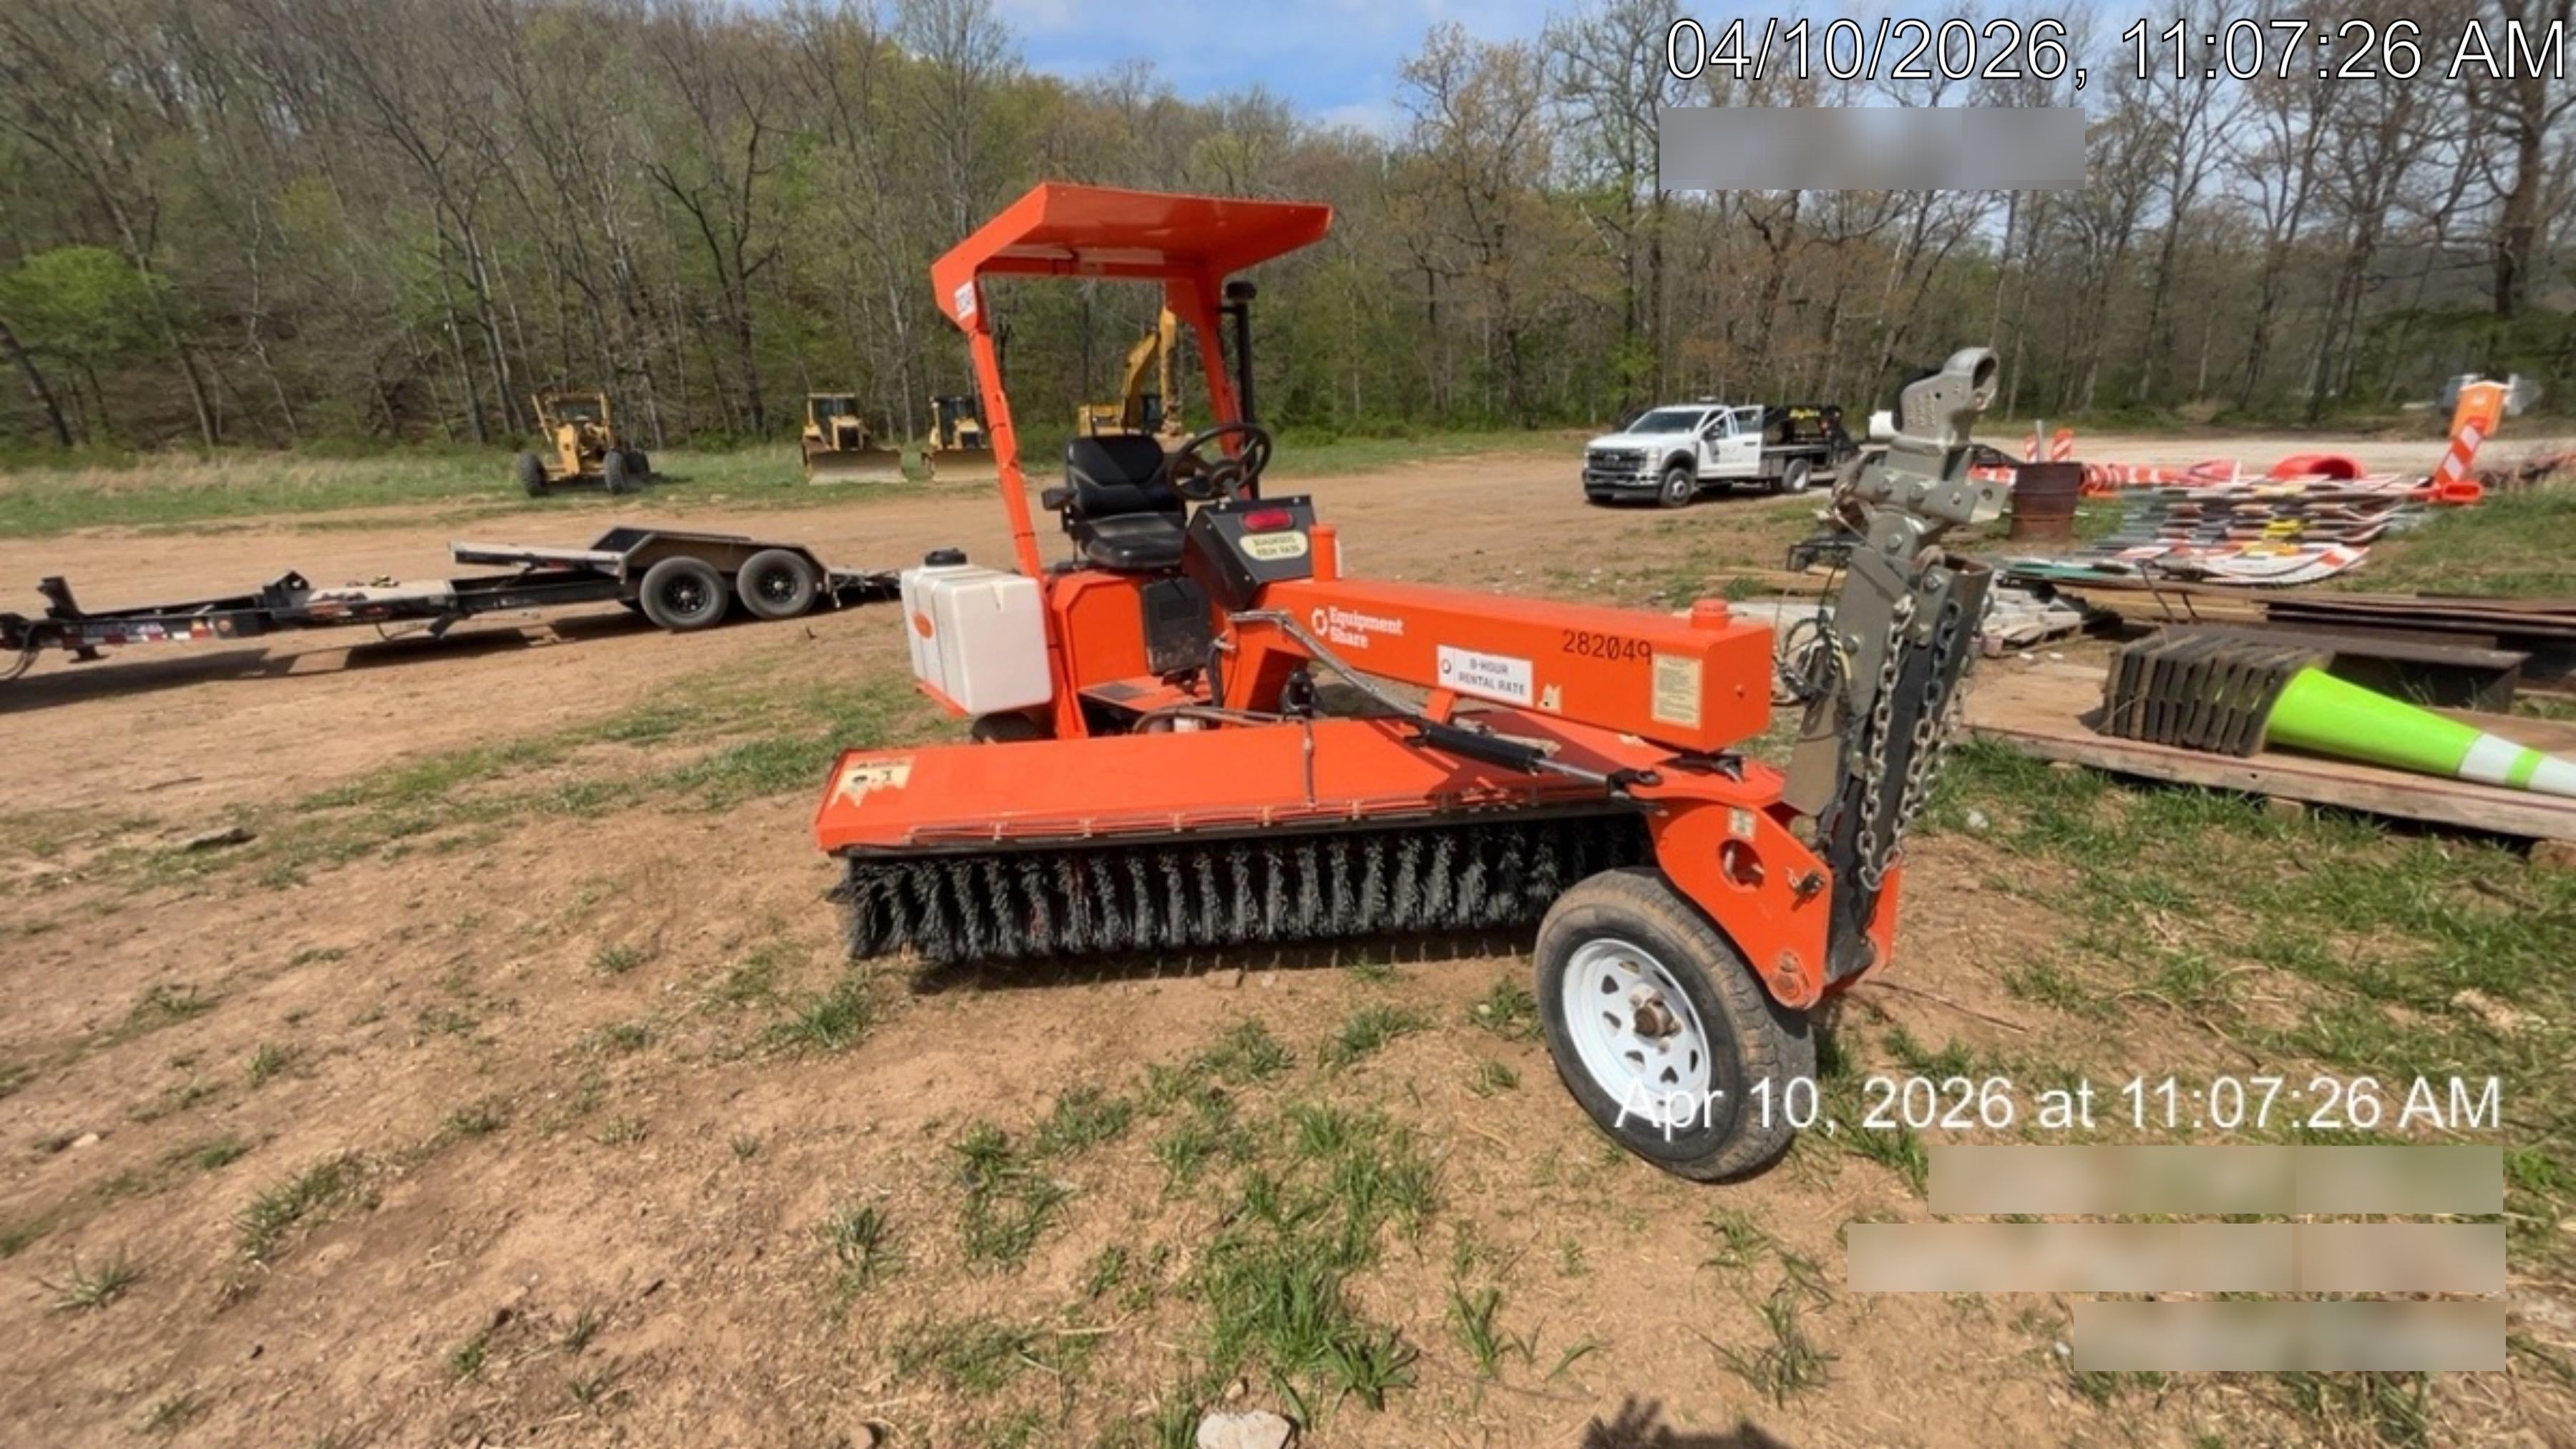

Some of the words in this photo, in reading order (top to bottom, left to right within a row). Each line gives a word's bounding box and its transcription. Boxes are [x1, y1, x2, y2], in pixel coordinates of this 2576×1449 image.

[1329, 605, 1405, 637] Equipment
[1330, 625, 1370, 650] Share
[1562, 628, 1652, 665] 282049
[1458, 671, 1496, 690] RENTAL
[1497, 679, 1526, 696] RATE
